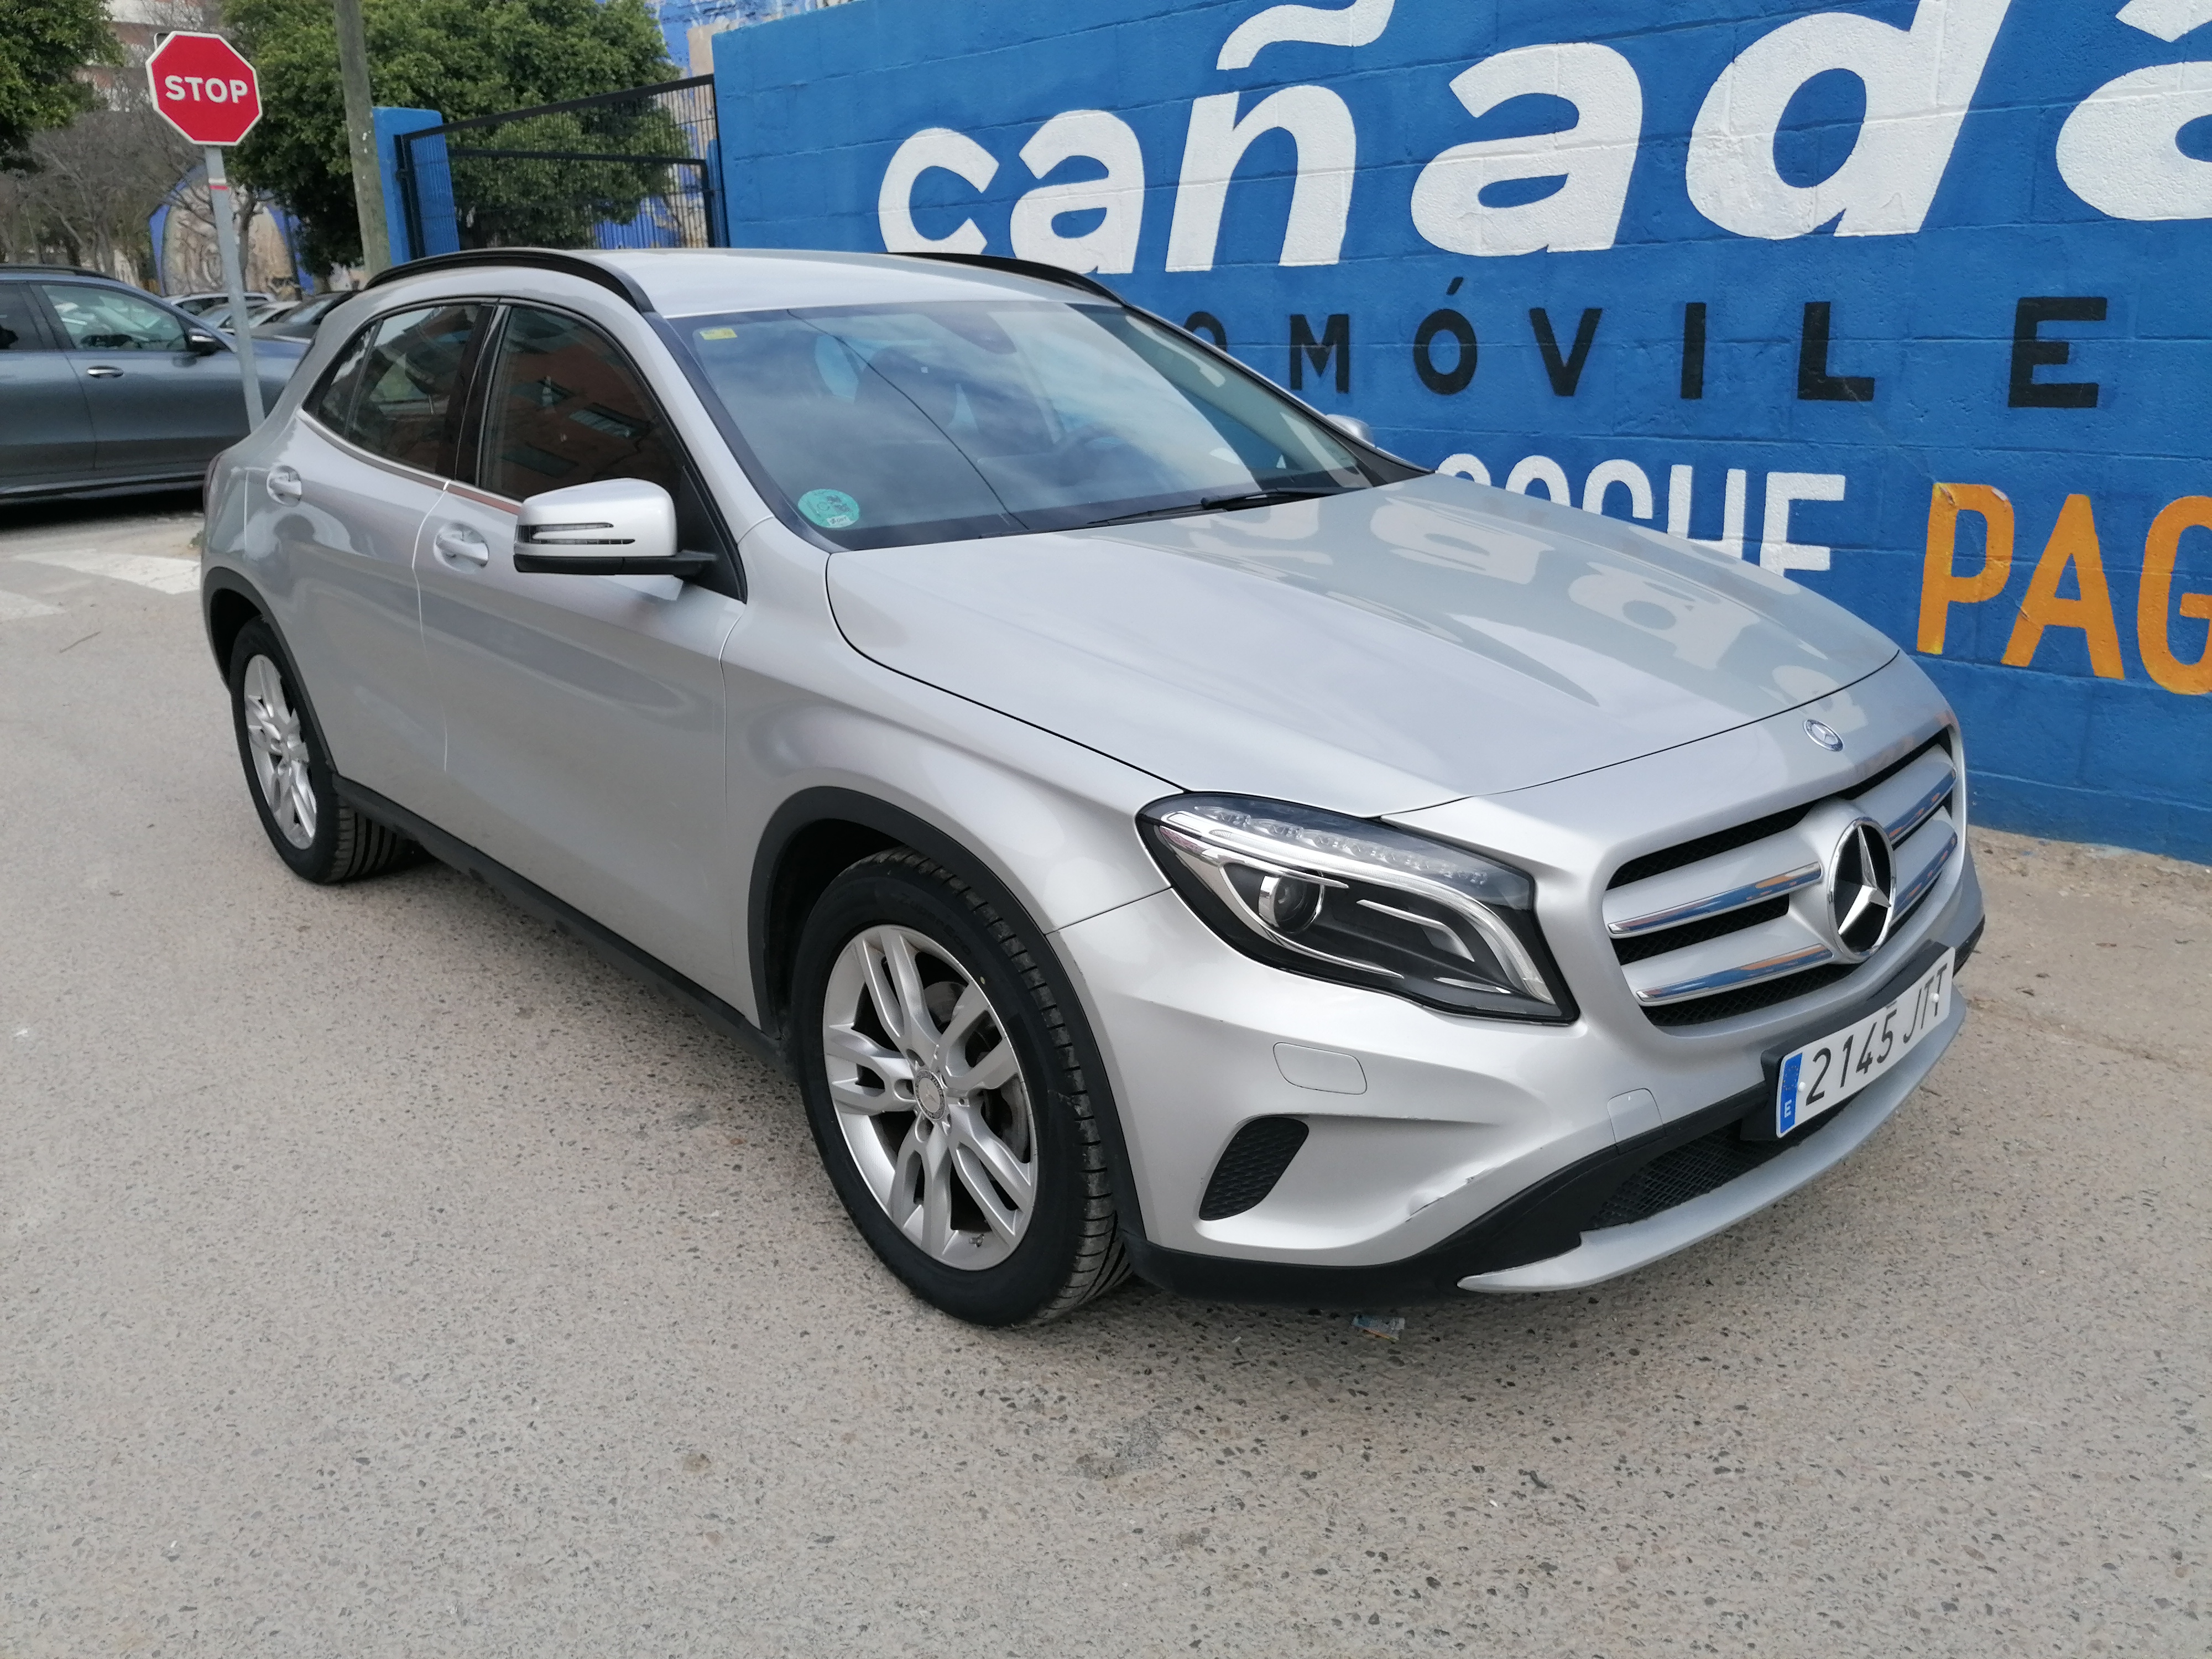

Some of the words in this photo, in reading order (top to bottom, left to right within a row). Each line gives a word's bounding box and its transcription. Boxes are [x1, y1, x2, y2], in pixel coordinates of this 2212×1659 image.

[165, 75, 248, 104] STOP
[1917, 482, 2212, 695] PAG
[1806, 1009, 1898, 1105] 2145
[1903, 963, 1947, 1044] JTT
[1784, 1099, 1792, 1118] E
